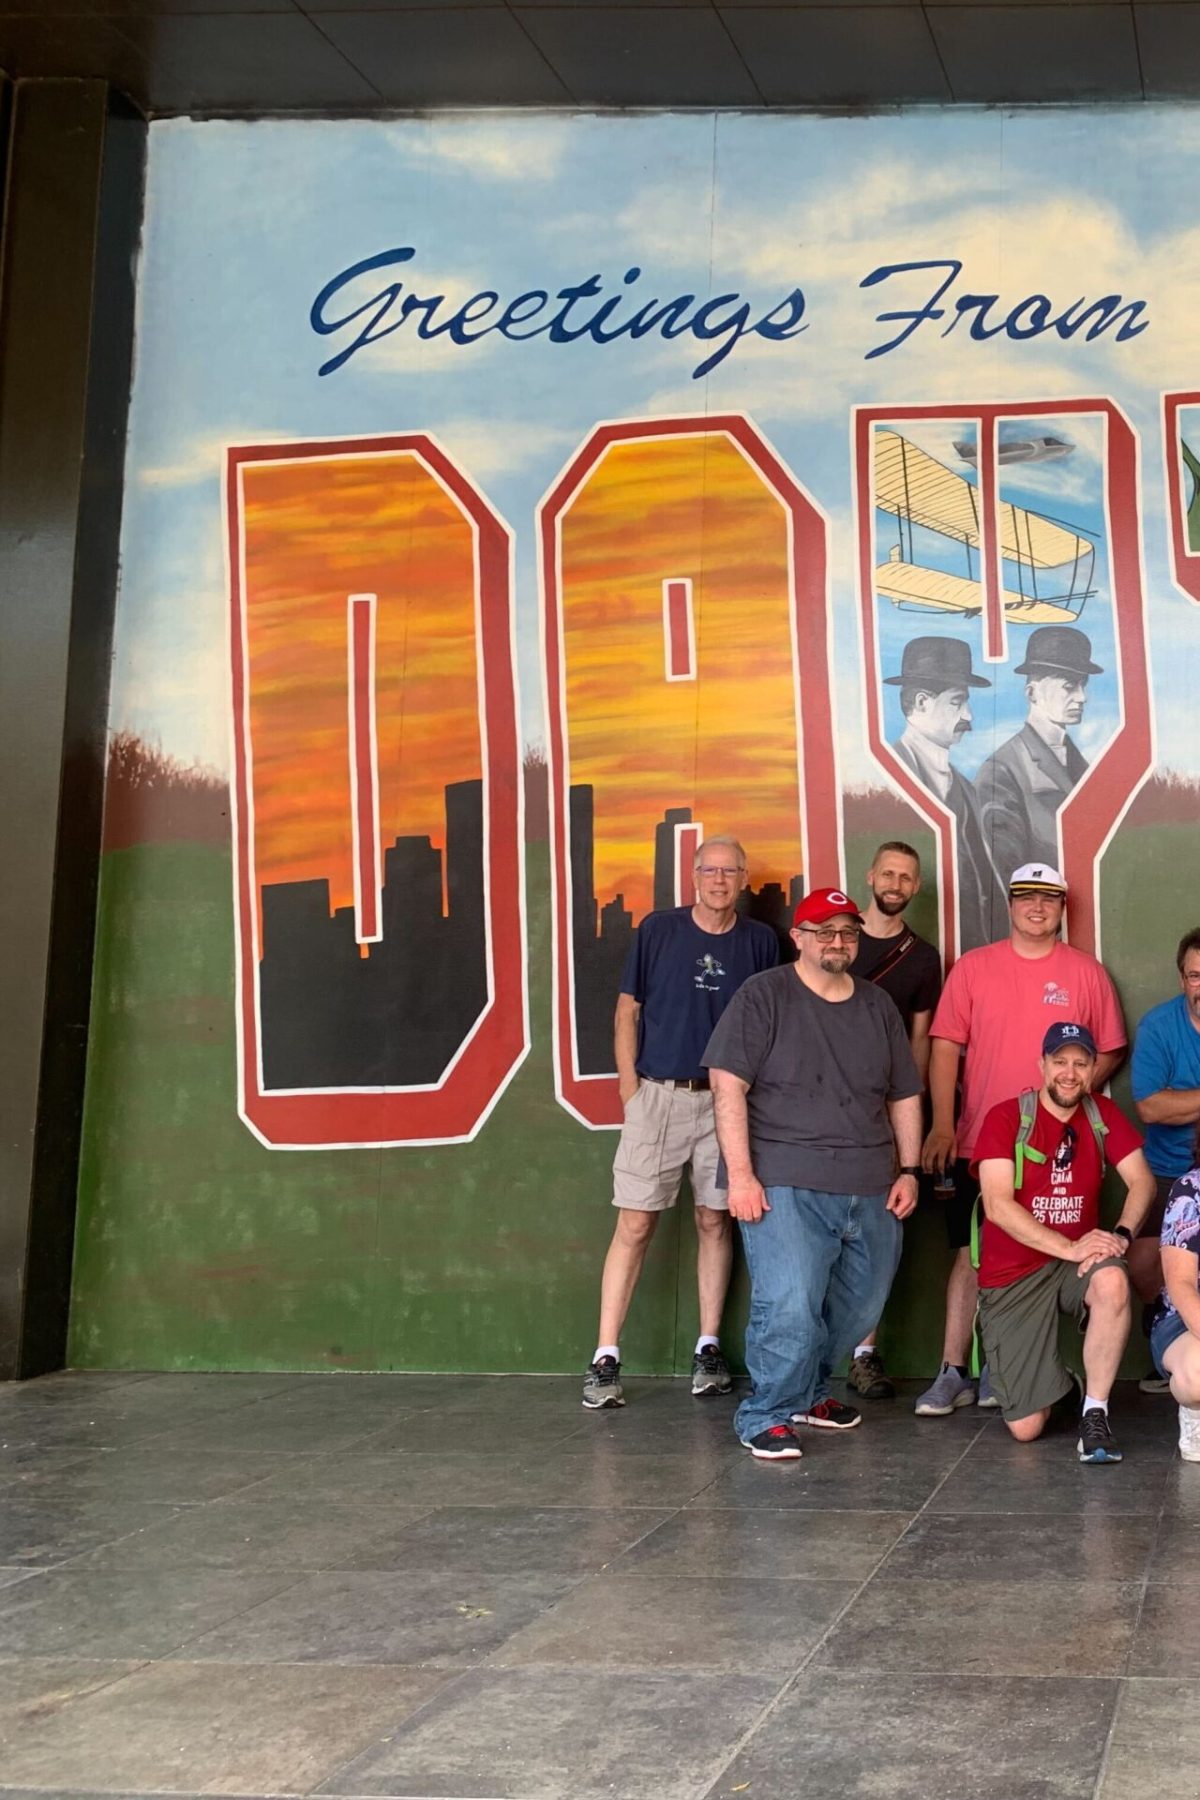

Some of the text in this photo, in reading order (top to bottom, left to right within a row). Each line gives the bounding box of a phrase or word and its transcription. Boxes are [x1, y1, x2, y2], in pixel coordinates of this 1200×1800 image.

[309, 246, 1150, 378] Greetings From
[1051, 1171, 1073, 1184] CALM
[1032, 1195, 1084, 1210] CELEBRATE
[1032, 1210, 1081, 1224] 25 YEARS!
